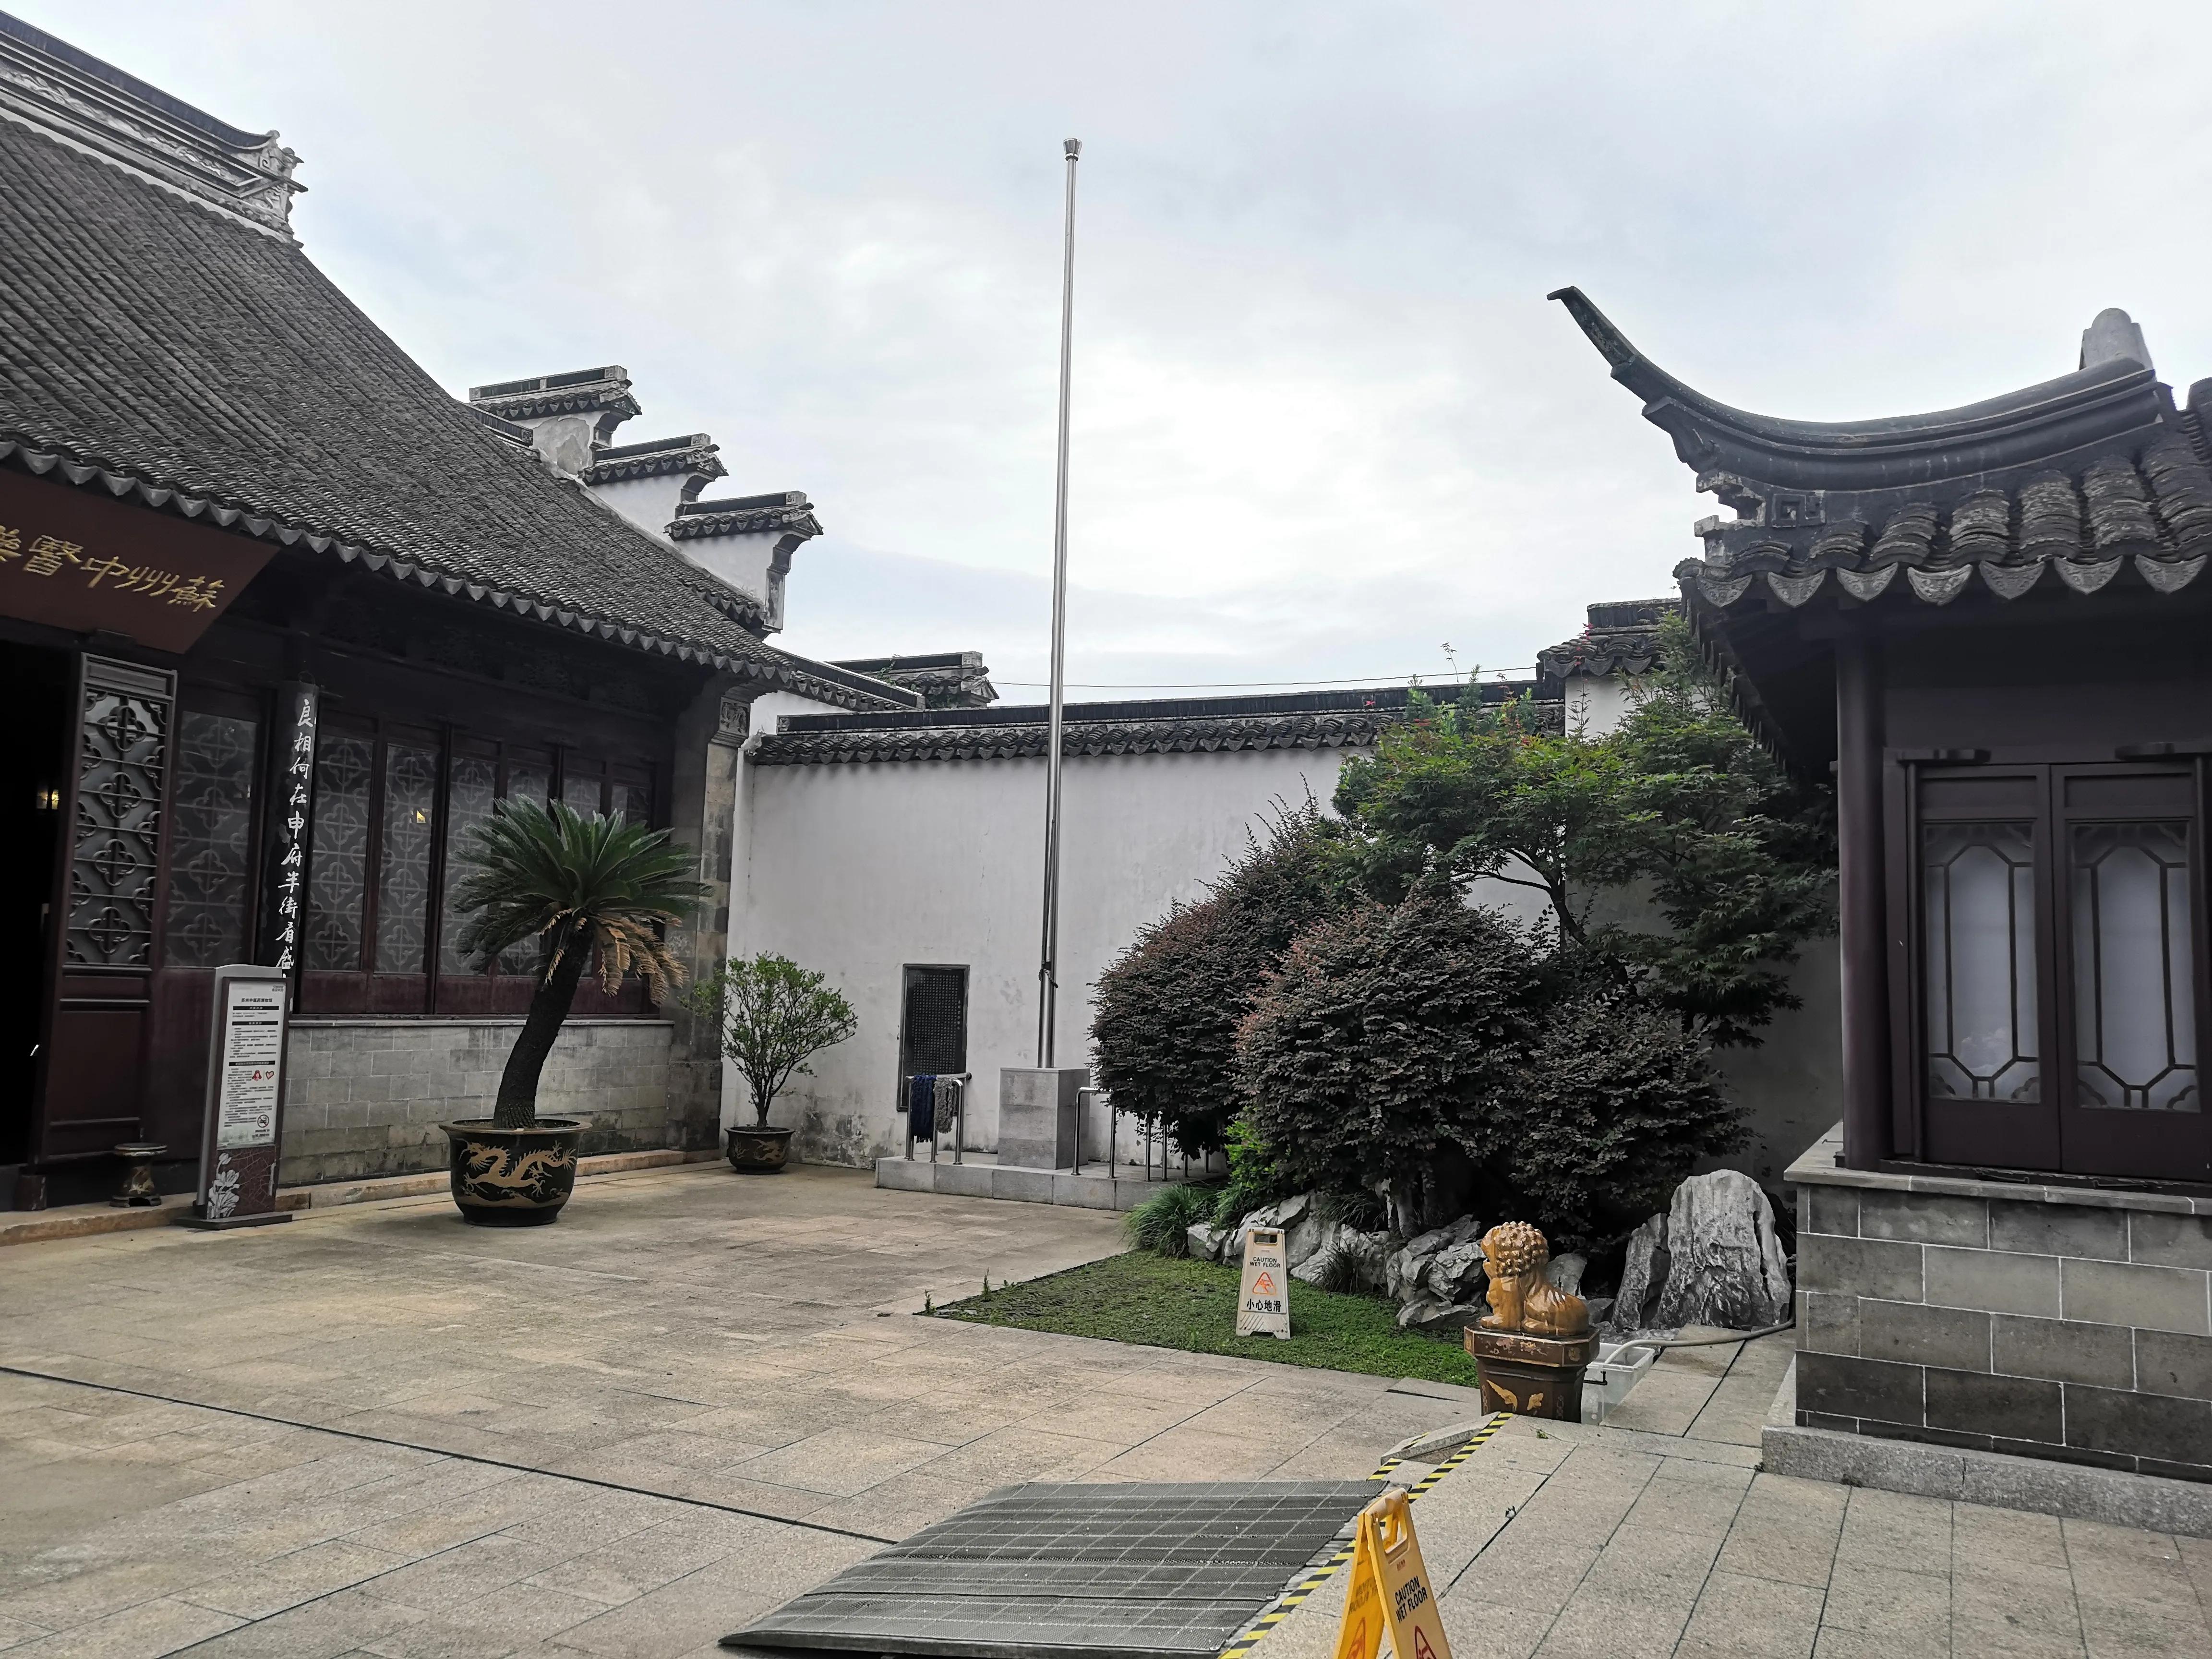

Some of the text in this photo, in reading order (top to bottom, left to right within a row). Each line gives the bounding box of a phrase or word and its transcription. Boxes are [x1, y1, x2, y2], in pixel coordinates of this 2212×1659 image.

[276, 698, 313, 978] 良相何在申府半街看盛
[1247, 1298, 1281, 1312] 小心地滑
[1395, 1576, 1420, 1605] CAUTION
[1395, 1587, 1428, 1623] WET FLOOR
